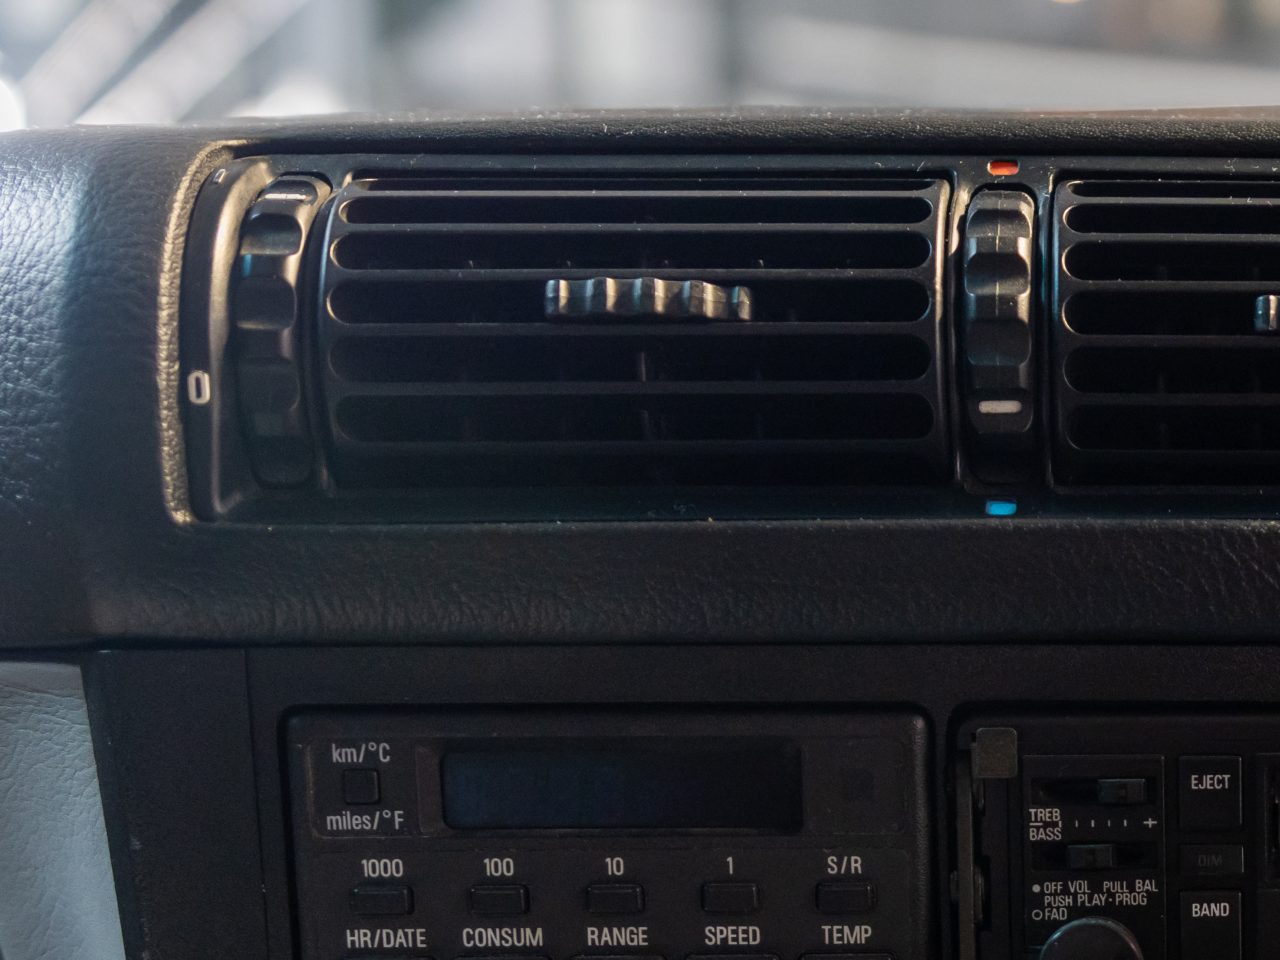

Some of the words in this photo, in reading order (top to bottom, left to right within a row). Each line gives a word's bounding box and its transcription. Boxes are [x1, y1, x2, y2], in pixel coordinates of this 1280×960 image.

[331, 742, 391, 763] km/°C
[1190, 774, 1231, 789] EJECT
[326, 810, 404, 831] miles/°F
[1029, 808, 1061, 822] TREB
[1029, 827, 1062, 841] BASS
[361, 859, 403, 878] 1000
[484, 858, 514, 876] 100
[605, 857, 624, 875] 10
[726, 857, 734, 875] 1
[827, 856, 862, 874] S/R
[1043, 882, 1063, 894] OFF
[1068, 880, 1091, 893] VOL
[1103, 881, 1129, 893] PULL
[1135, 879, 1159, 892] BAL
[1044, 895, 1073, 907] PUSH
[1191, 902, 1230, 918] BAND
[1044, 907, 1068, 921] FAD
[346, 929, 427, 948] HR/DATE
[462, 928, 543, 947] CONSUM
[587, 927, 648, 946] RANGE
[704, 926, 761, 945] SPEED
[821, 925, 872, 944] TEMP
